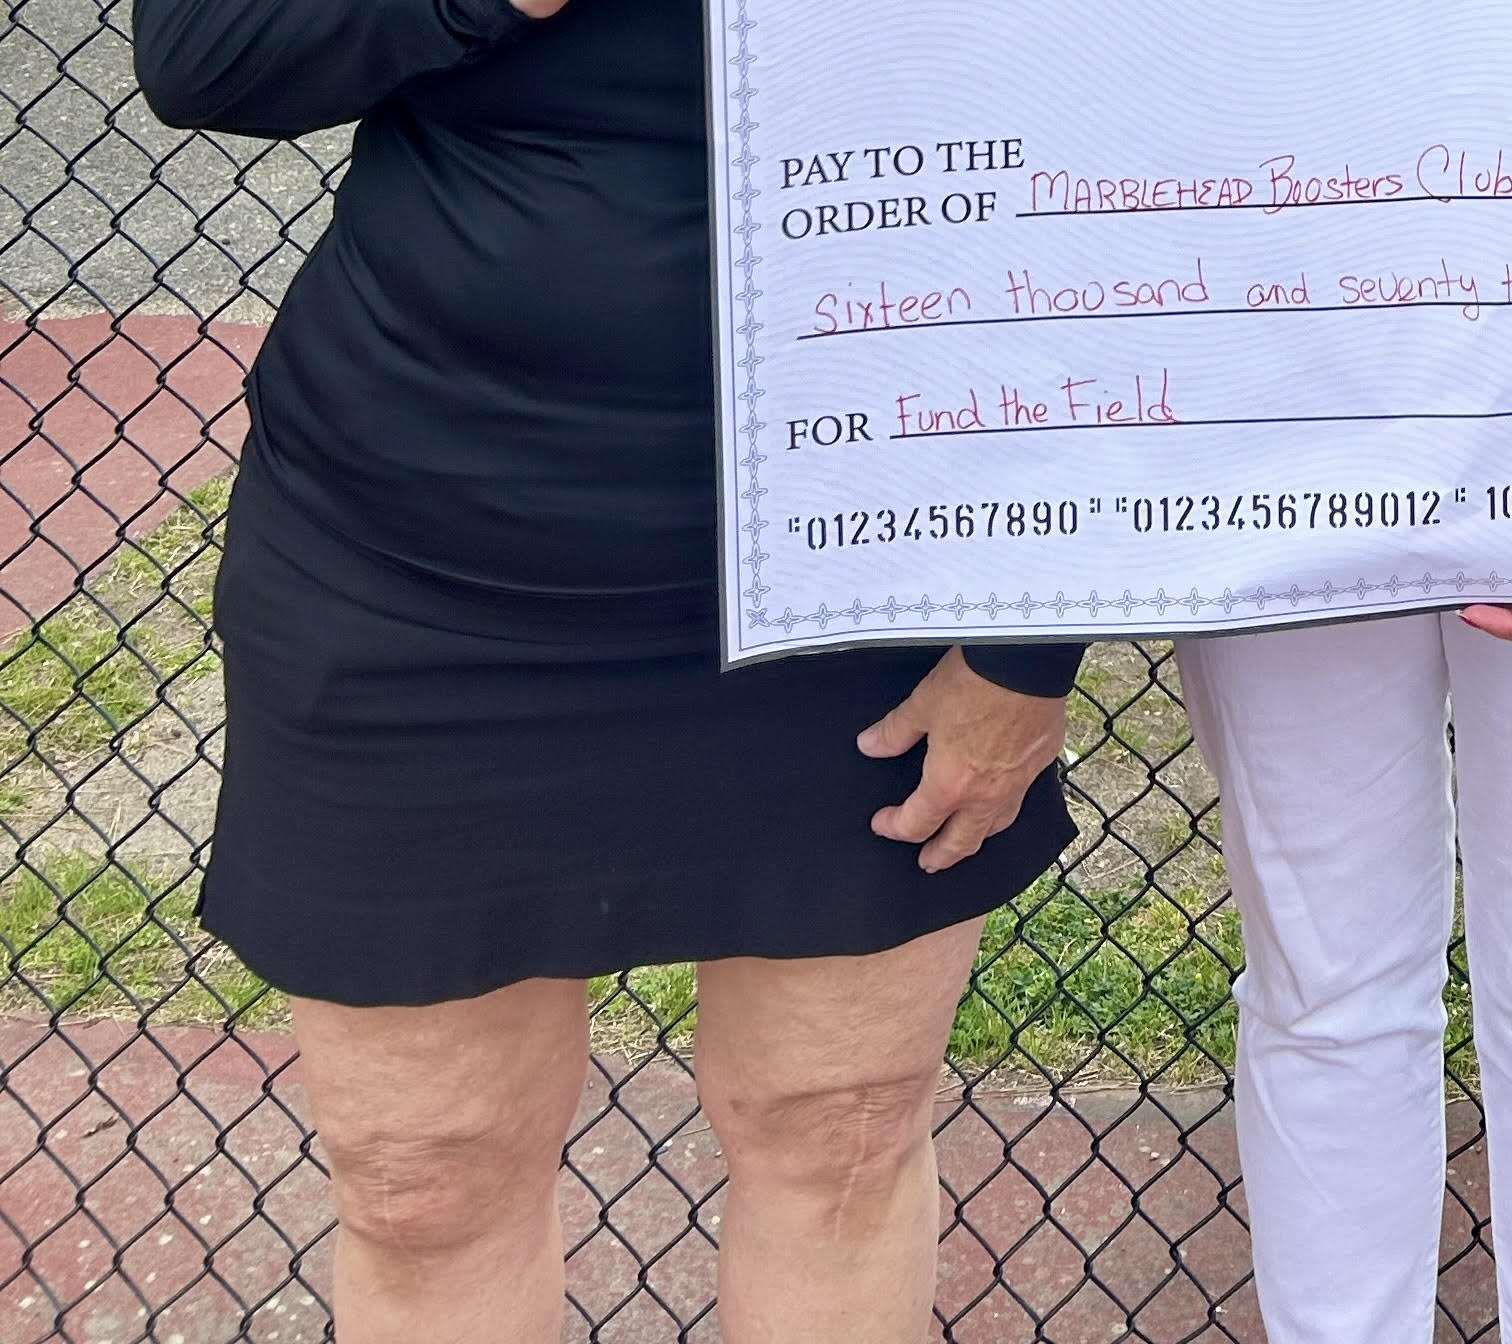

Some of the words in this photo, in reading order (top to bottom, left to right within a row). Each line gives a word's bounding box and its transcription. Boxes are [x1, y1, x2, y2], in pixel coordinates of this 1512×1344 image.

[780, 152, 855, 189] PAY
[863, 145, 924, 180] TO
[936, 138, 1025, 173] THE
[781, 196, 930, 240] ORDER
[940, 191, 997, 226] OF
[1031, 171, 1252, 211] MARBLEHEAD
[1006, 257, 1209, 313] thousand
[1247, 272, 1310, 306] and
[896, 388, 985, 437] Fund
[1001, 385, 1048, 428] the
[1061, 368, 1180, 425] Field
[786, 412, 873, 450] FOR
